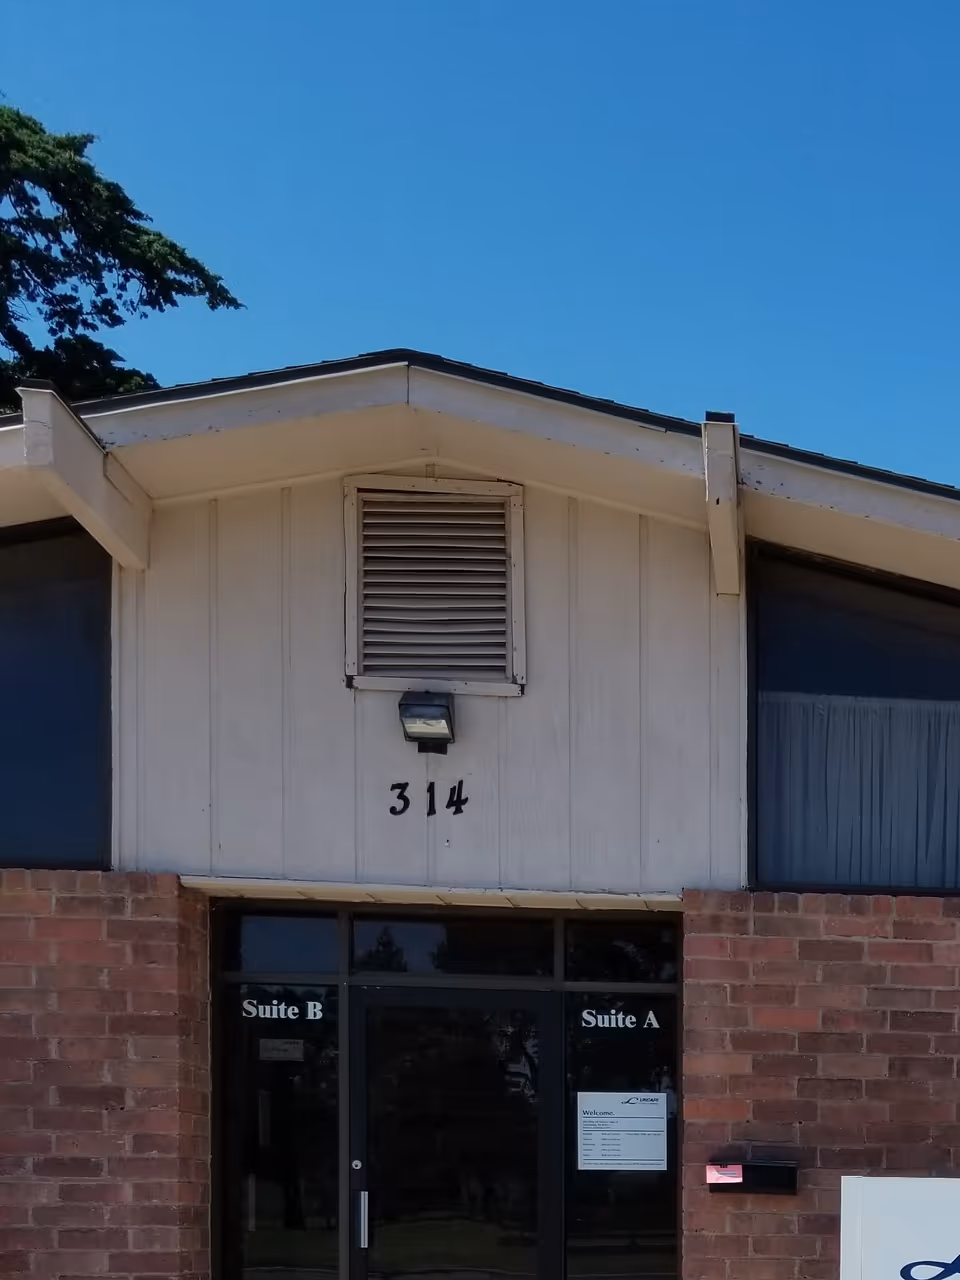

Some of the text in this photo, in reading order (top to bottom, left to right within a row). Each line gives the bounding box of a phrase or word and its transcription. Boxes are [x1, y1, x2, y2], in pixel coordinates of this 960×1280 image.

[389, 779, 469, 817] 314
[242, 999, 323, 1020] Suite B
[581, 1009, 660, 1029] Suite A
